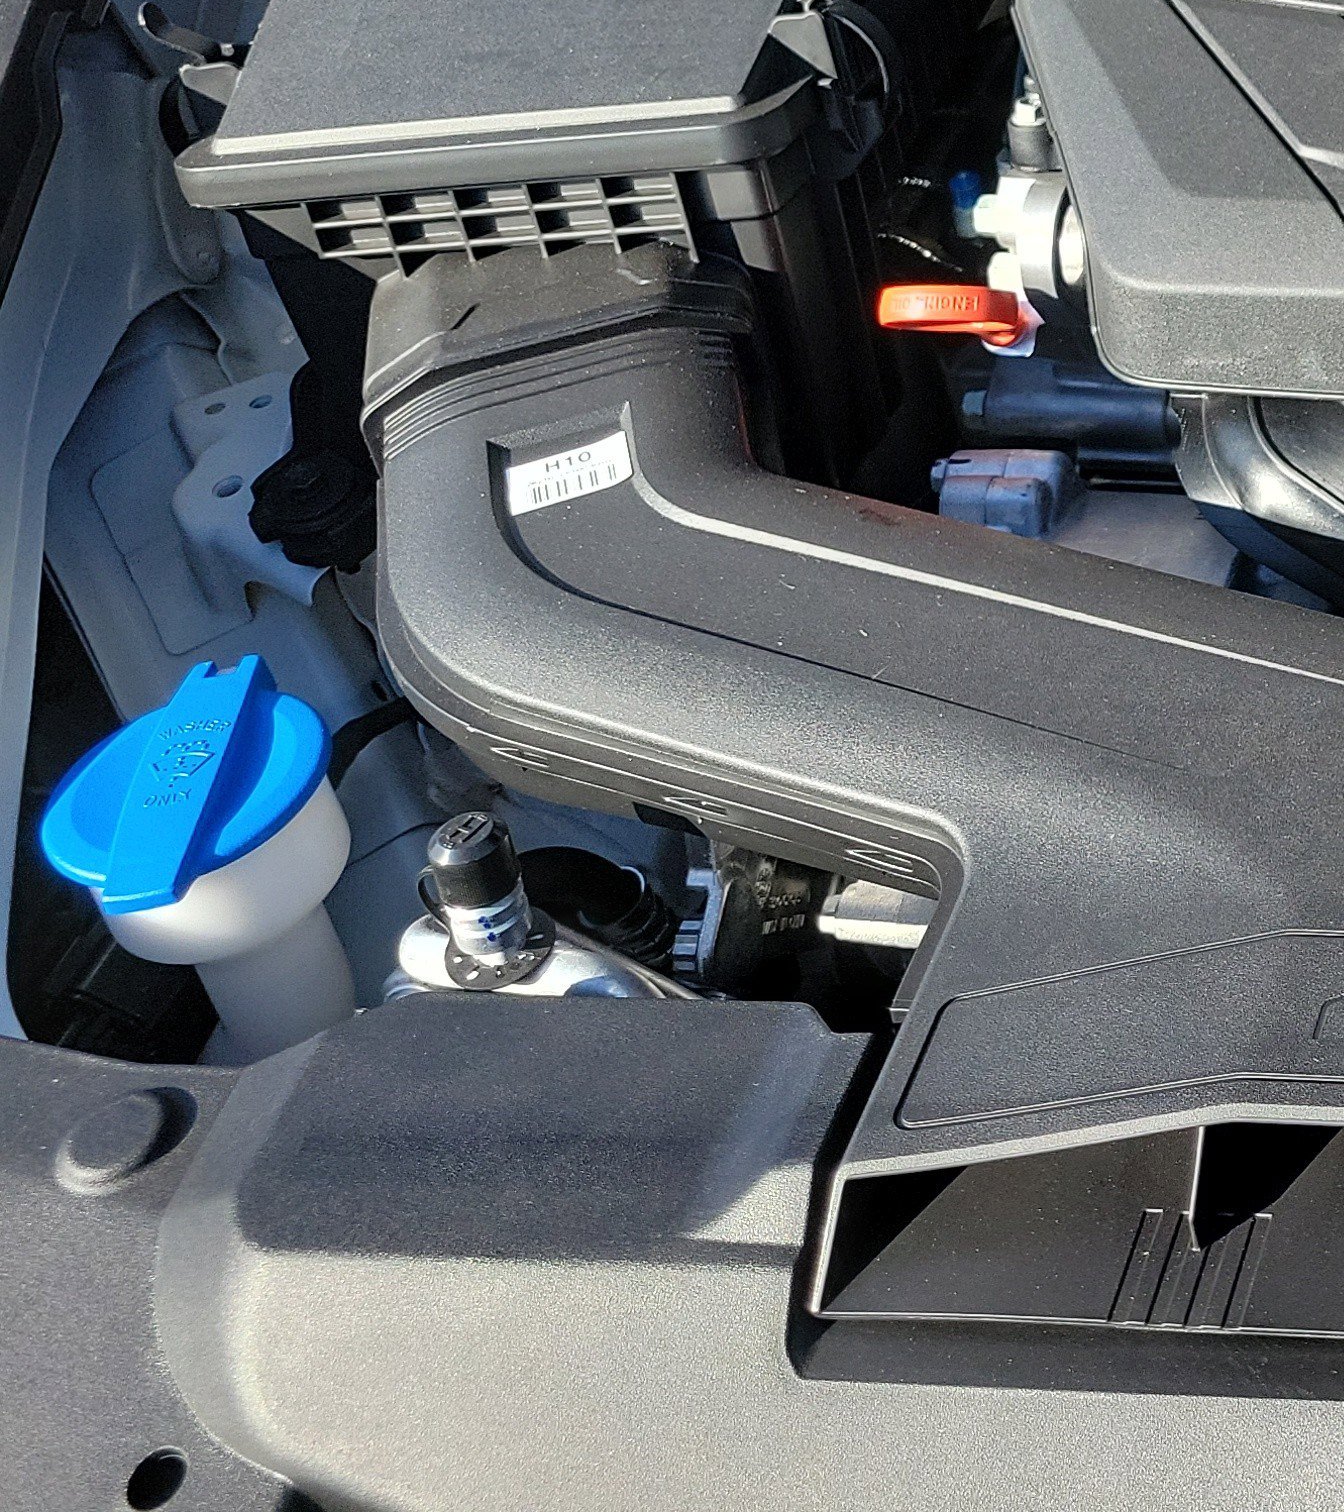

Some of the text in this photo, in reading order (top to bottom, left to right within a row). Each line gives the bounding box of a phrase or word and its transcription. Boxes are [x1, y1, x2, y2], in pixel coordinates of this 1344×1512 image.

[545, 451, 591, 473] H10
[159, 719, 231, 741] WASHER
[143, 789, 192, 808] ONLY
